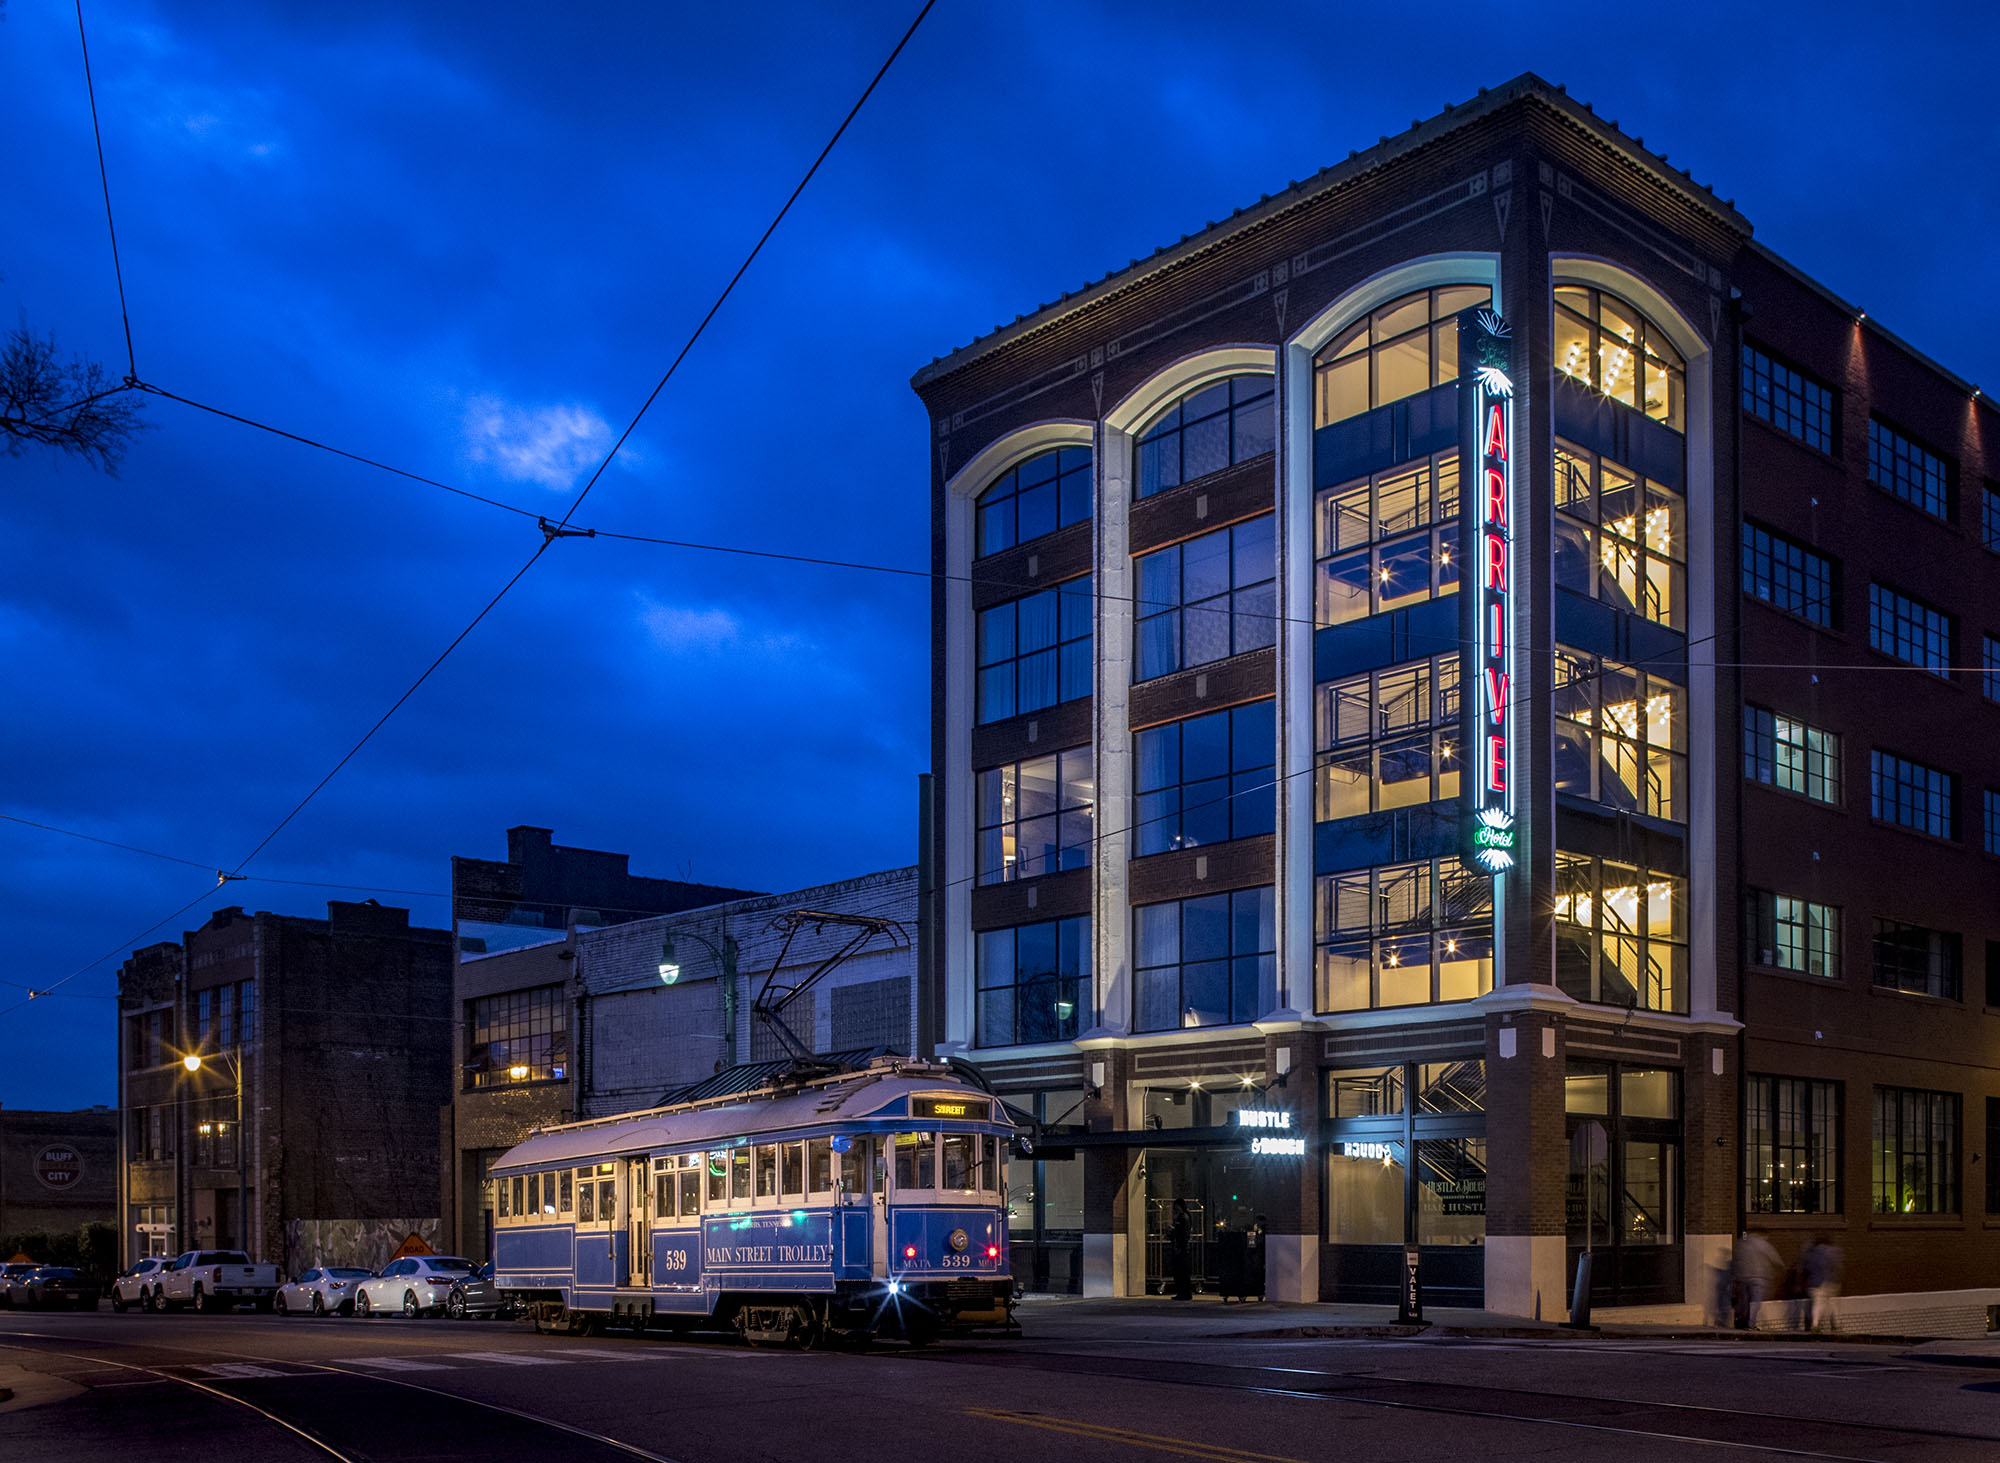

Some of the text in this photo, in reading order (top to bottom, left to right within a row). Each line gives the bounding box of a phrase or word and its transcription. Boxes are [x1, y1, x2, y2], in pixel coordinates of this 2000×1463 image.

[1483, 403, 1508, 793] ARRIVE
[1477, 827, 1513, 847] Hotel
[1239, 1109, 1290, 1128] HUSTLE
[46, 1152, 73, 1161] BLUFF
[48, 1171, 70, 1180] CITY
[1424, 1203, 1485, 1211] BAR HUSTL
[404, 1245, 425, 1253] ROAD
[707, 1245, 828, 1263] MAIN STREET TROLLEY
[666, 1249, 687, 1270] 539
[903, 1259, 931, 1268] MATA
[942, 1255, 970, 1267] 539
[1409, 1268, 1417, 1309] VALET
